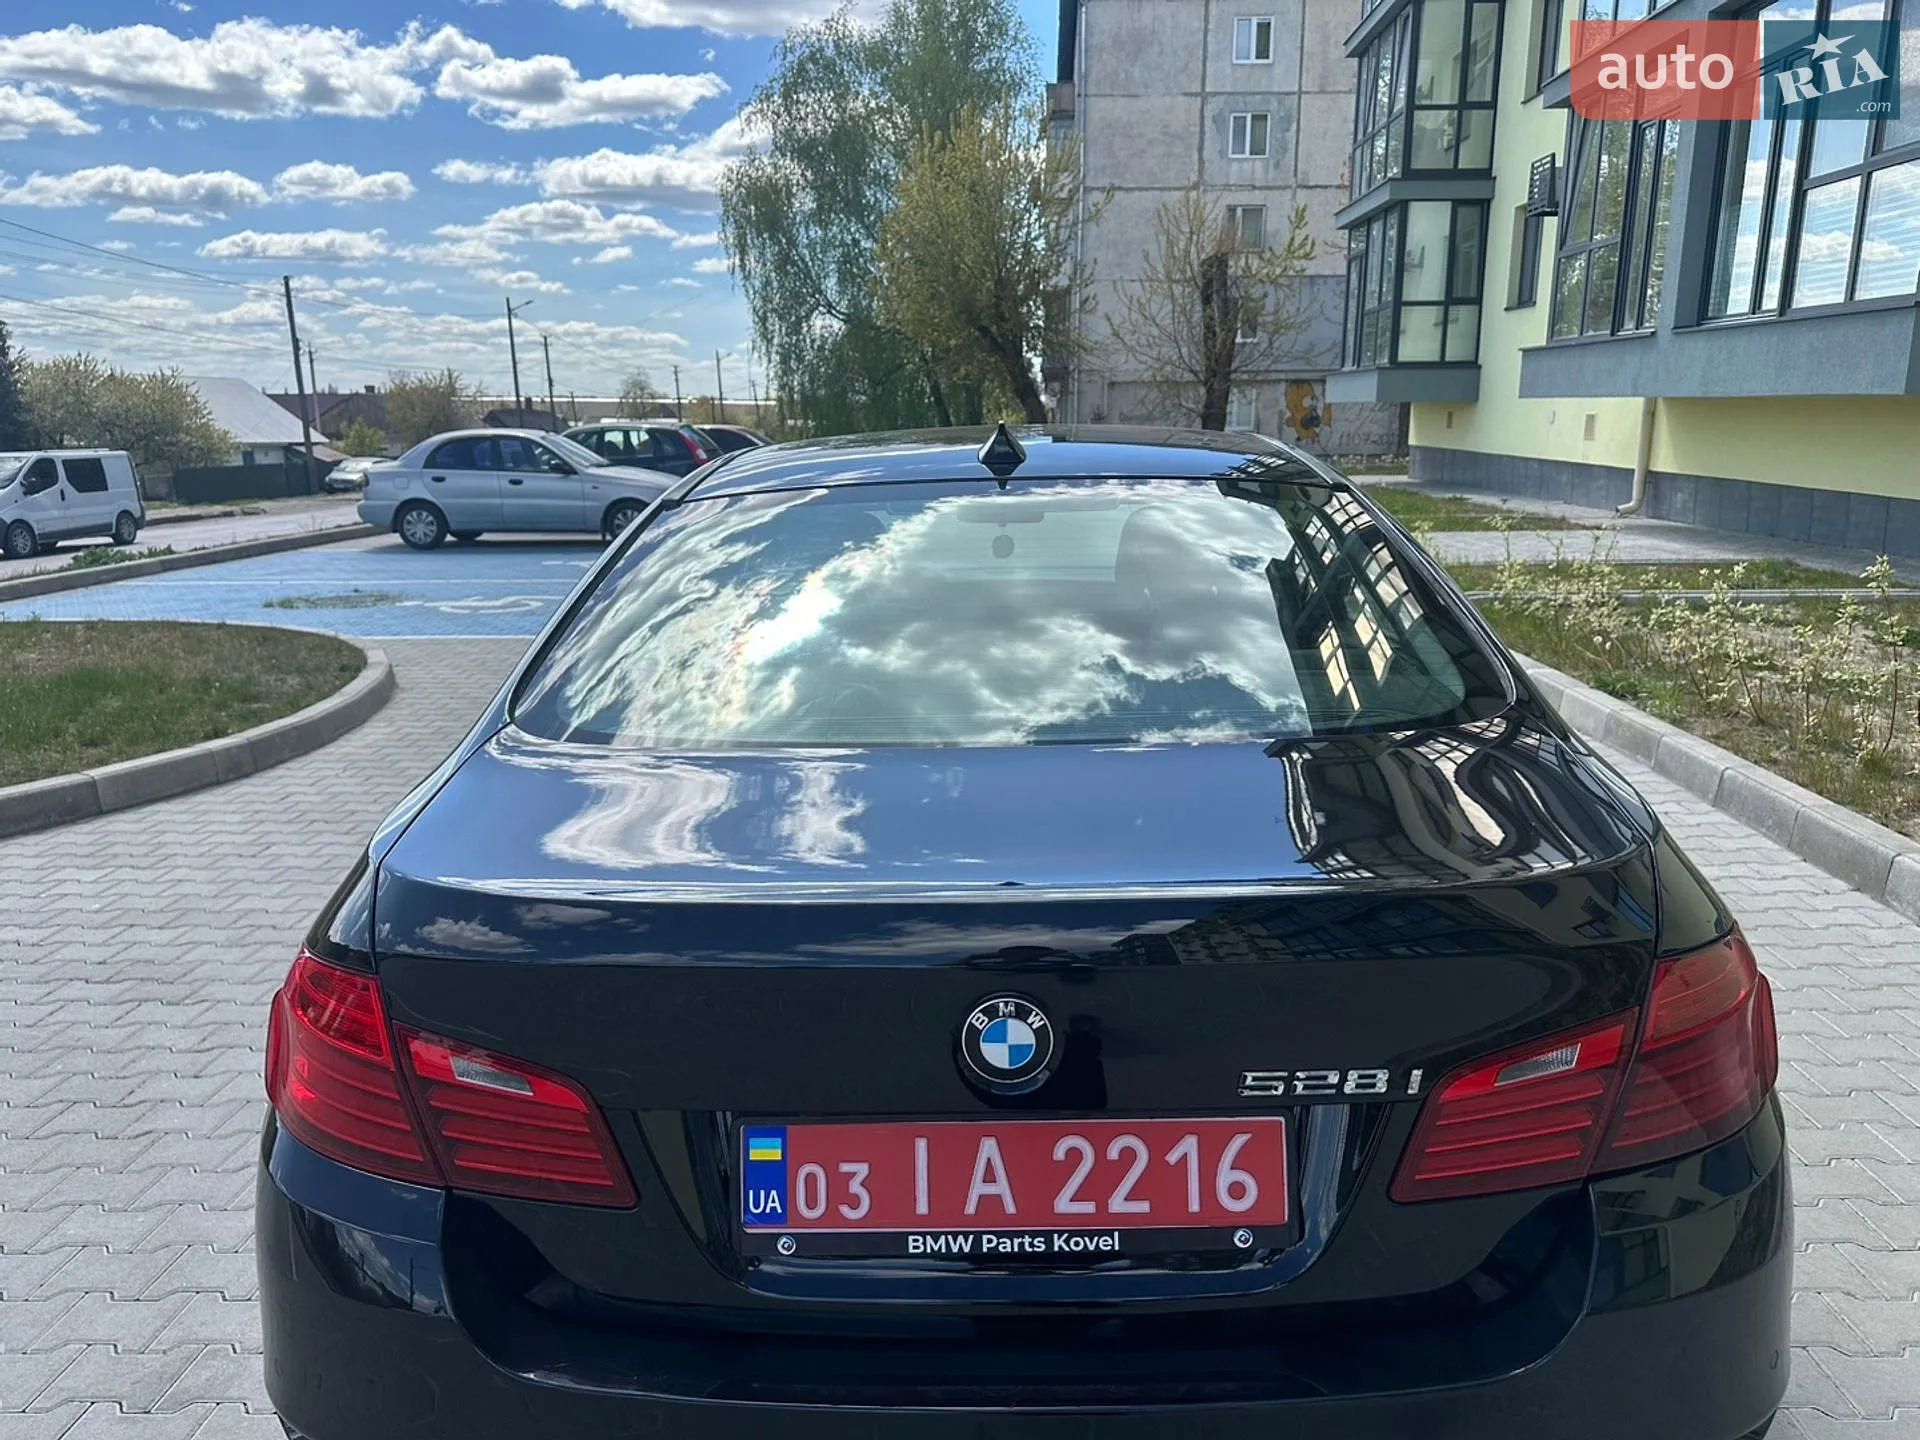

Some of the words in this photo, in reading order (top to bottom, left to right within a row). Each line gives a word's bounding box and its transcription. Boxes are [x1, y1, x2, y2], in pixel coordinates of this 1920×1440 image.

[970, 1001, 1046, 1030] BMW
[796, 1162, 872, 1221] 03
[1053, 1133, 1259, 1214] 2216
[748, 1189, 783, 1216] UA
[907, 1235, 974, 1254] BMW
[981, 1233, 1046, 1253] Parts
[1053, 1232, 1120, 1251] Kovel
